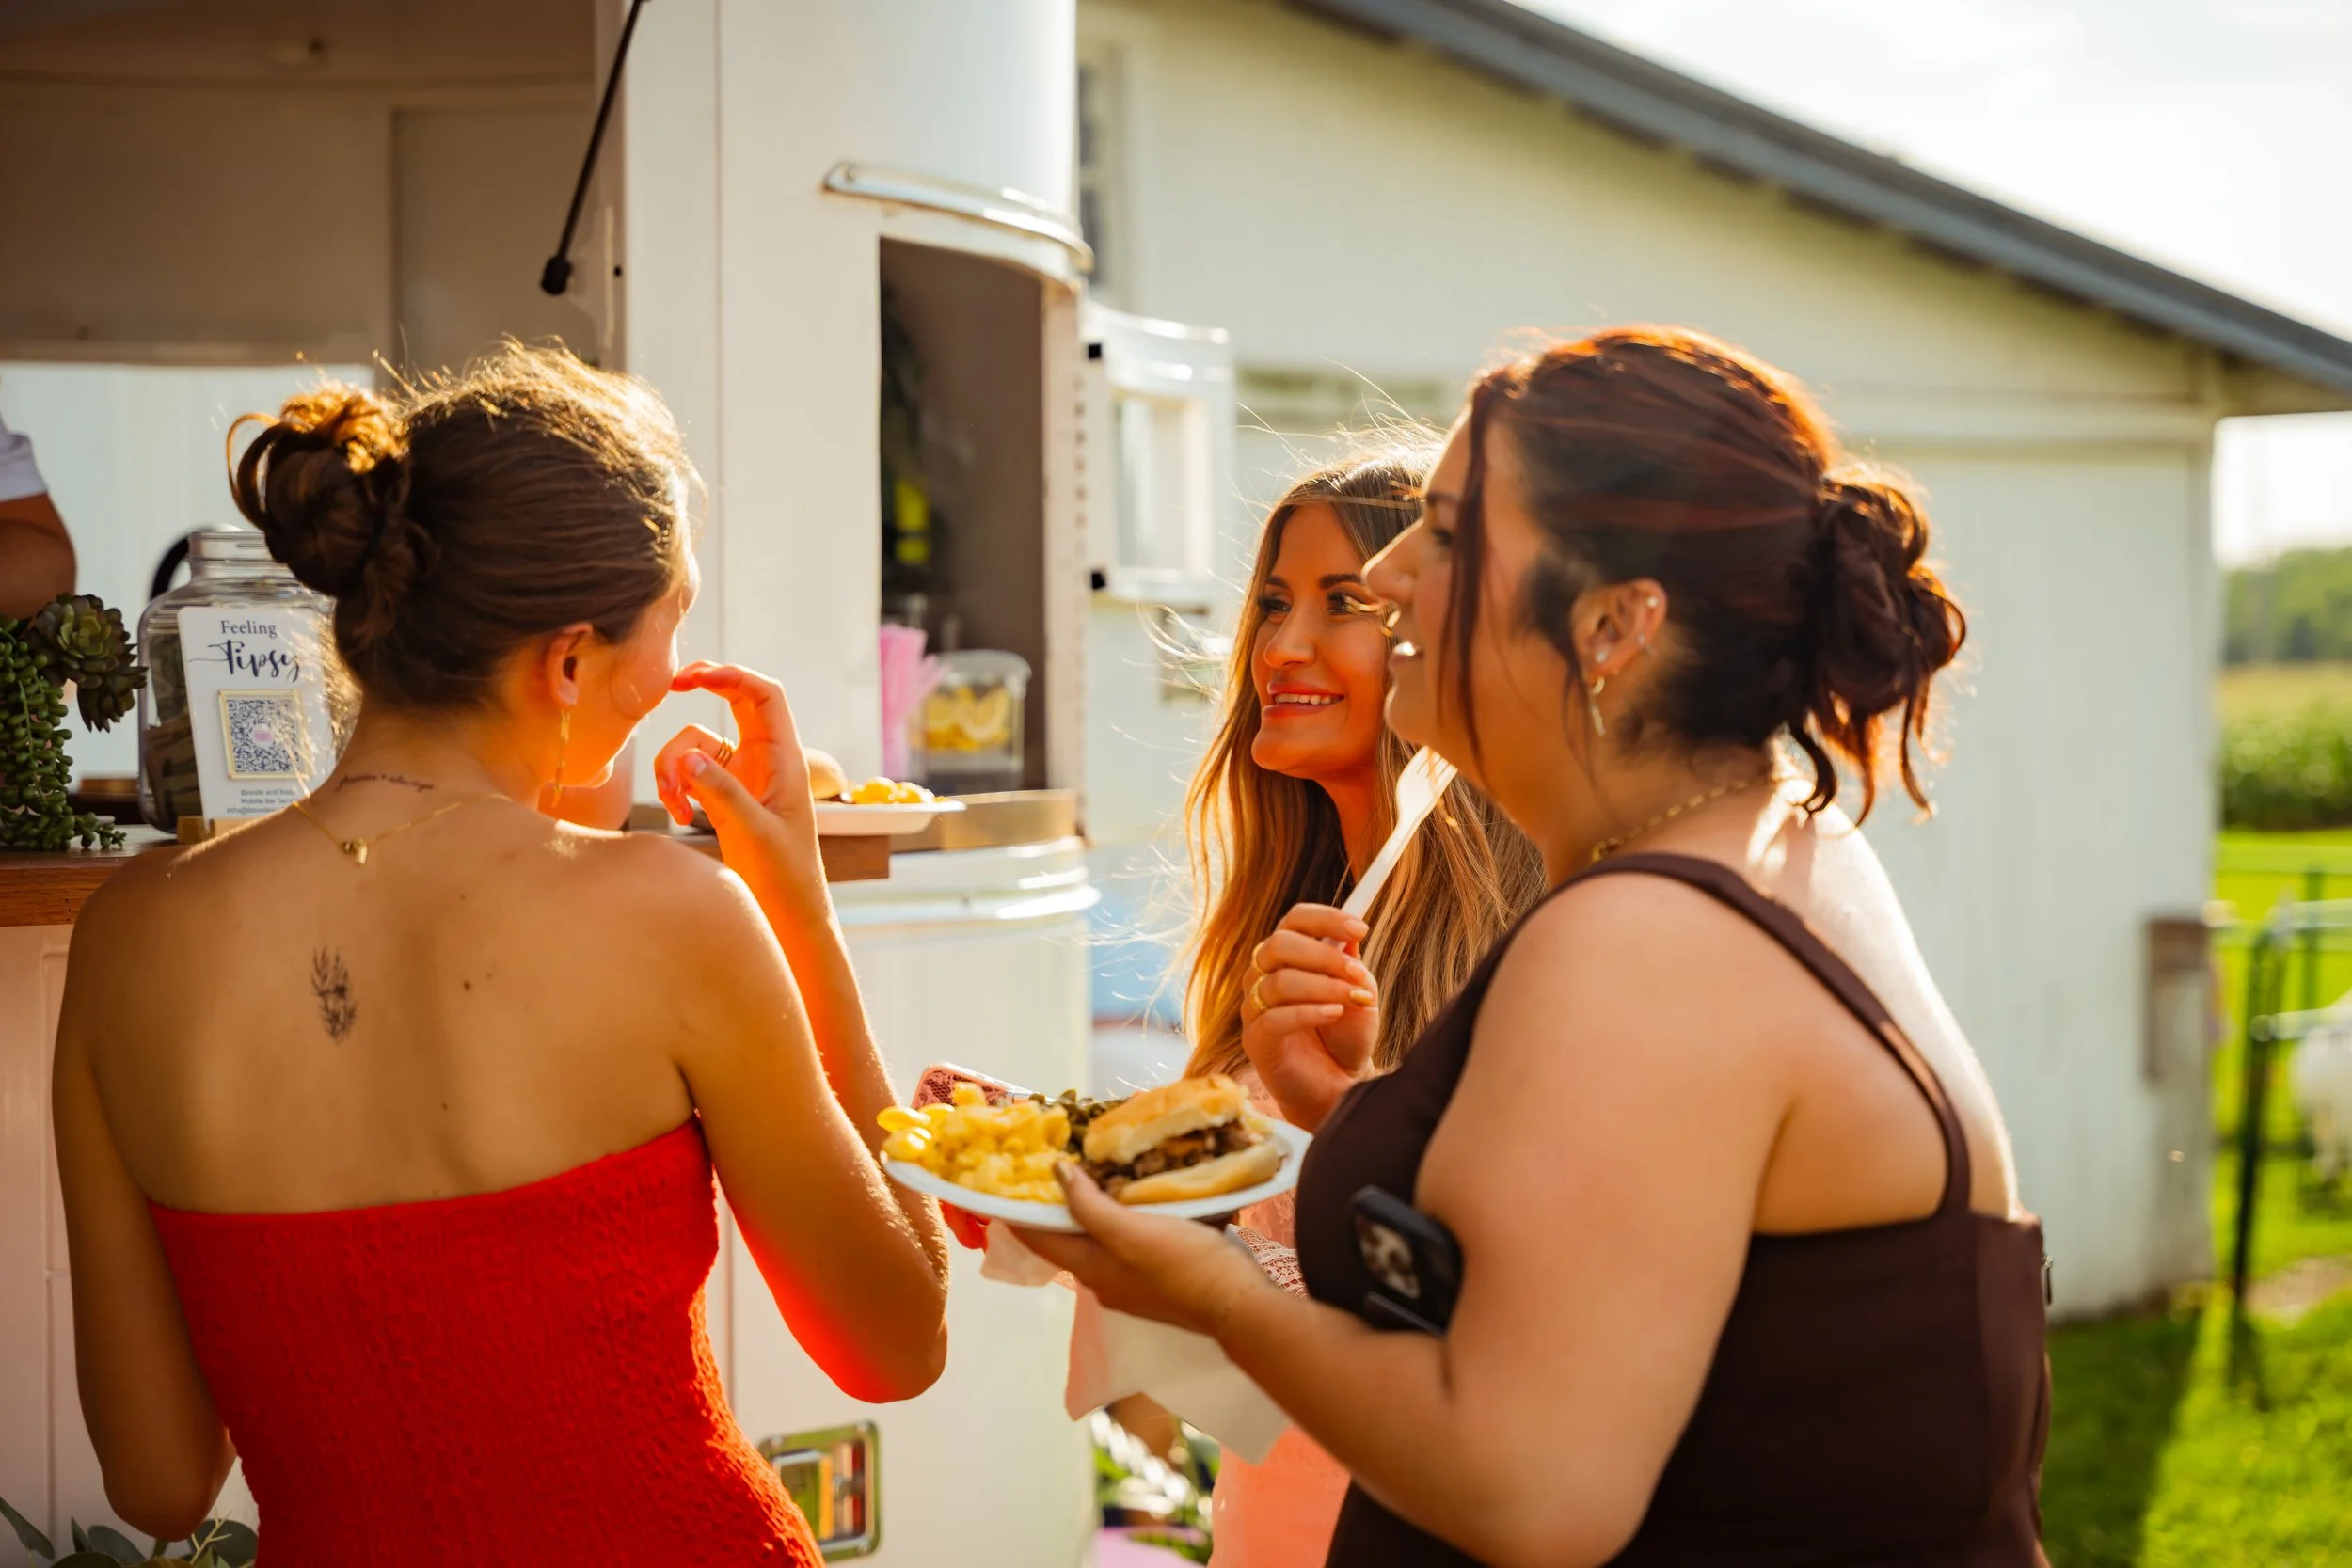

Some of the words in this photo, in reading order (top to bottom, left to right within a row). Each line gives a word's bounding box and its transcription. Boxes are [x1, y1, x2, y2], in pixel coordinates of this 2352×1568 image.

[220, 620, 278, 639] Feeling
[189, 639, 300, 684] Tipsy
[265, 788, 278, 797] and
